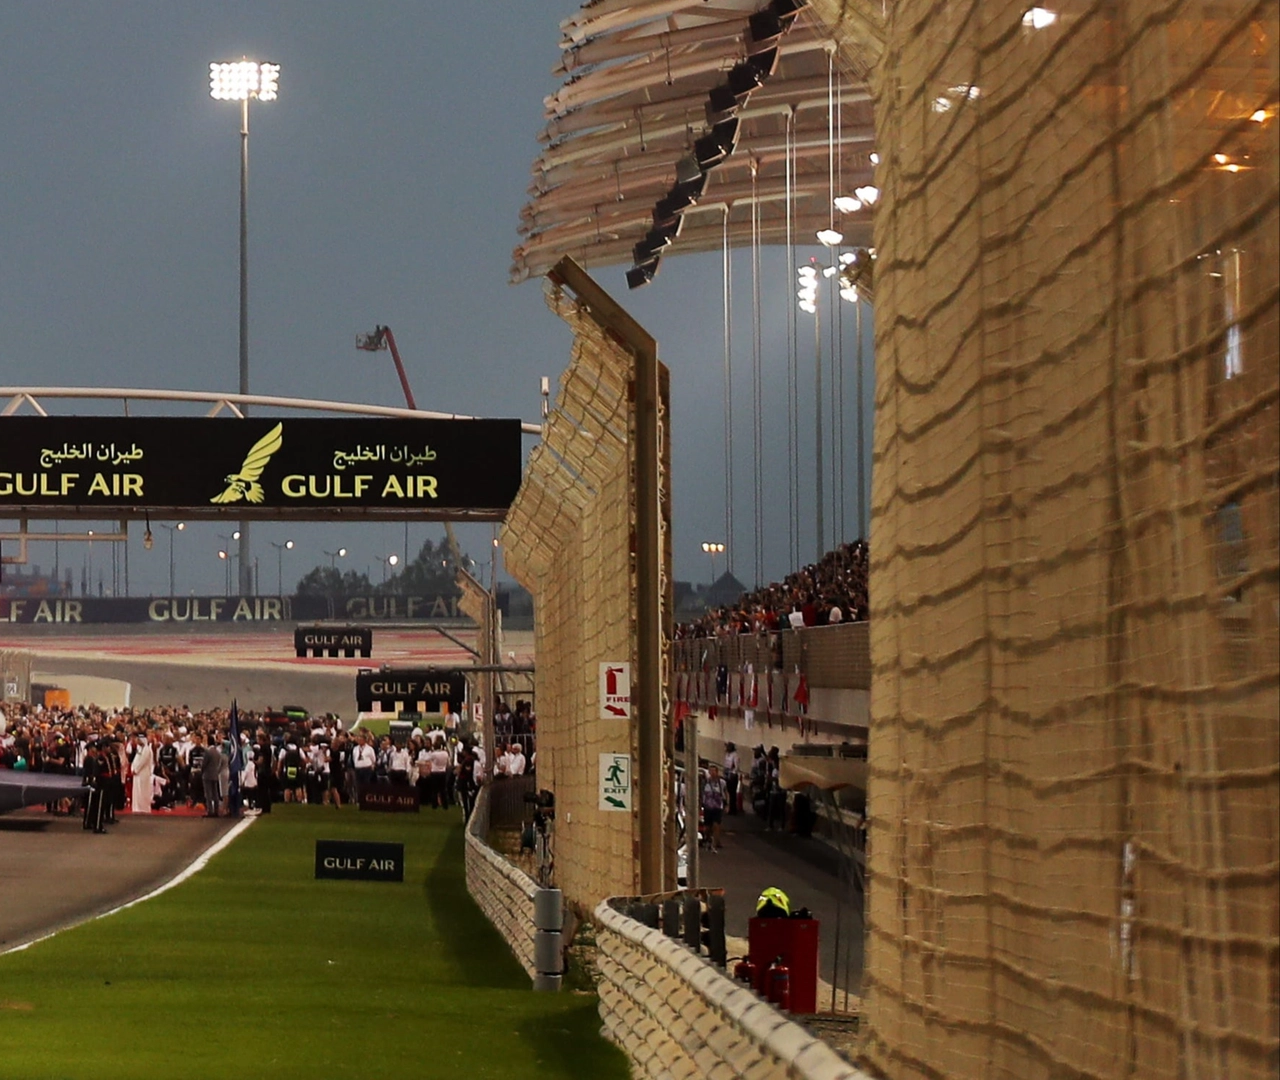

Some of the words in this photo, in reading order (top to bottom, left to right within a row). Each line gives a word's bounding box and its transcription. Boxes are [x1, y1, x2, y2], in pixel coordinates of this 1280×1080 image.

[40, 443, 92, 468] الخليج
[96, 443, 144, 466] طيران
[333, 444, 386, 470] الخليج
[389, 445, 437, 467] طيران
[87, 472, 144, 497] AIR
[281, 474, 374, 498] GULF
[381, 474, 438, 498] AIR
[33, 599, 83, 622] AIR
[148, 599, 226, 621] GULF
[233, 598, 281, 621] AIR
[346, 596, 423, 618] GULF
[431, 595, 462, 618] AI
[305, 635, 338, 645] GULF
[341, 635, 362, 645] AIR
[371, 682, 417, 694] GULF
[421, 682, 451, 694] AIR
[323, 857, 365, 869] GULF
[368, 858, 395, 871] AIR
